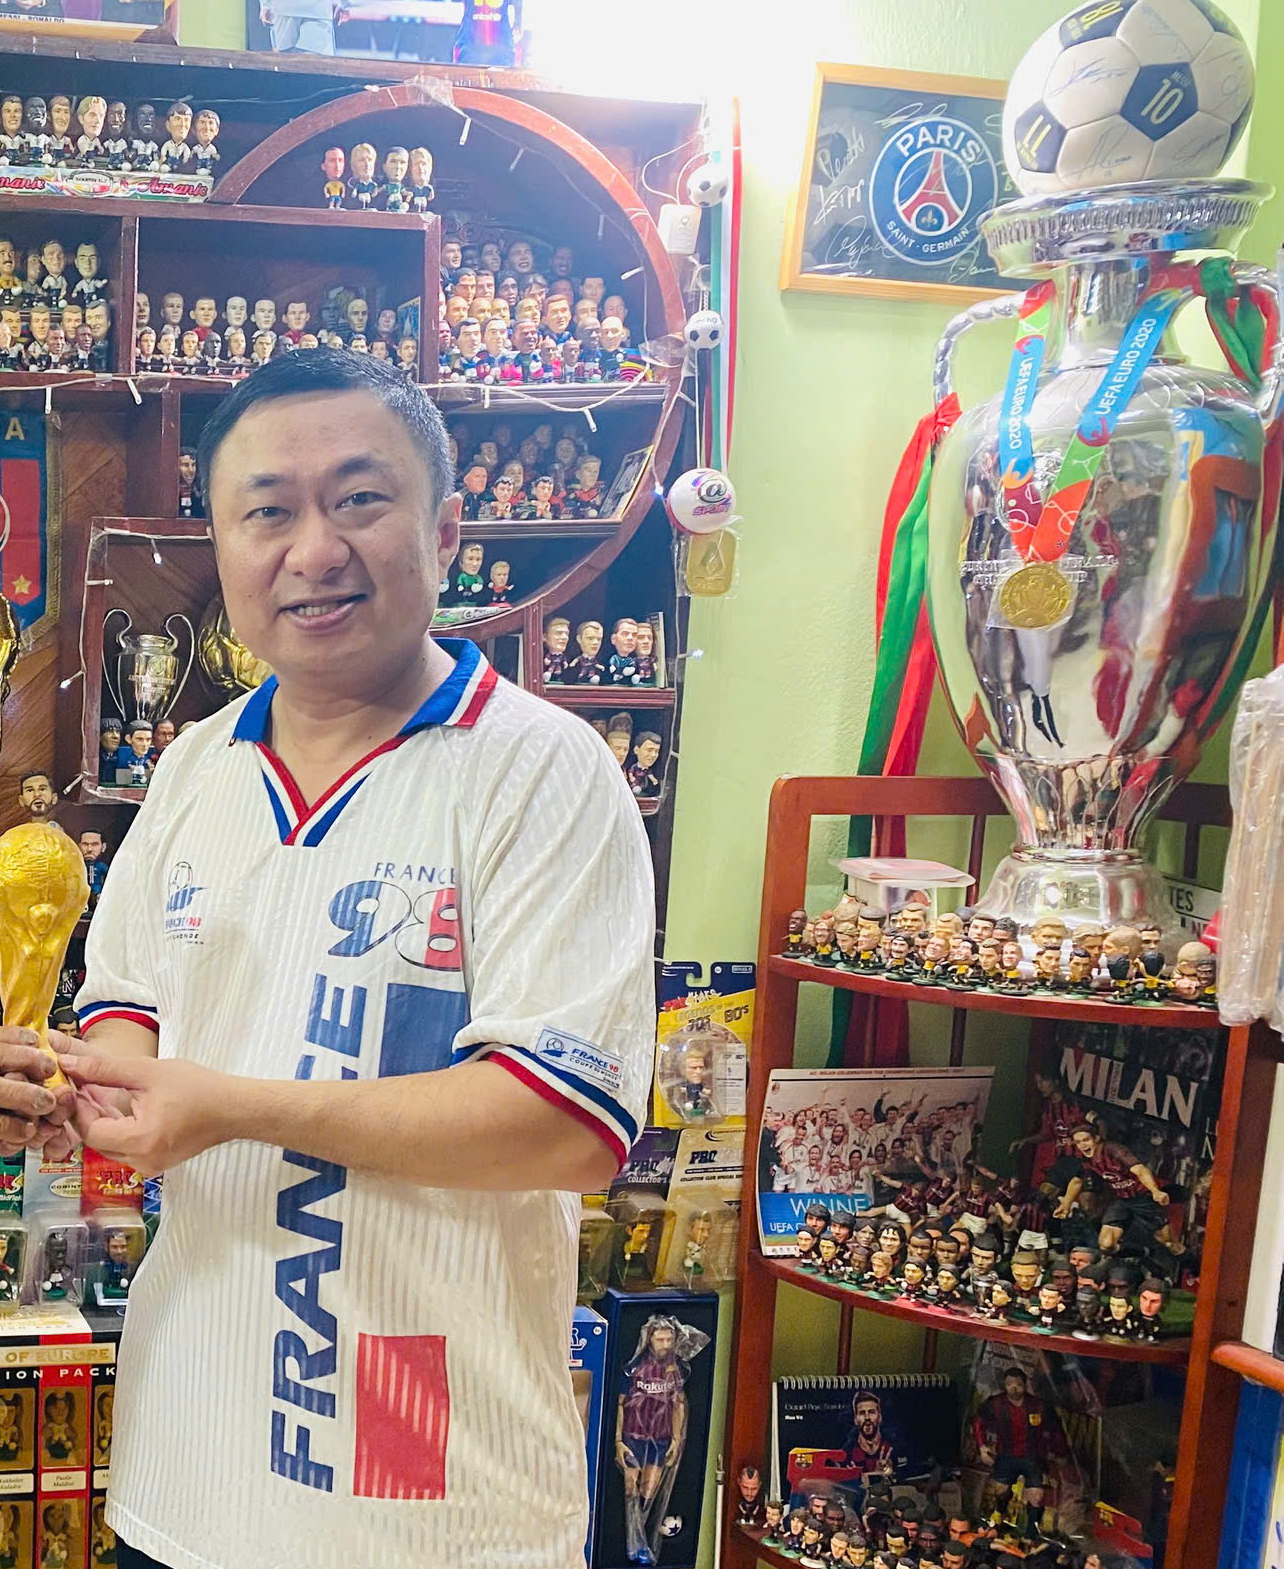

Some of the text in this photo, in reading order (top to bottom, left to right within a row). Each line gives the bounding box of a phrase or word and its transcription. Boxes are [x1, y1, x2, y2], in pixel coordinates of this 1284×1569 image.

[1141, 79, 1184, 125] 10
[896, 125, 981, 162] PARIS
[887, 220, 916, 248] SAINT
[922, 228, 971, 253] GERMAIN
[1095, 318, 1156, 415] UEFA EURO 2020
[1008, 357, 1033, 450] UEFA EURO 2020
[570, 1058, 593, 1069] COUPE
[571, 1048, 620, 1073] FRANCE 98
[1060, 1048, 1199, 1129] MILAN
[270, 973, 368, 1494] FRANE
[769, 1222, 795, 1232] UEFA
[6, 1352, 30, 1364] OF
[36, 1348, 110, 1362] EUROPE
[60, 1367, 116, 1378] PACK
